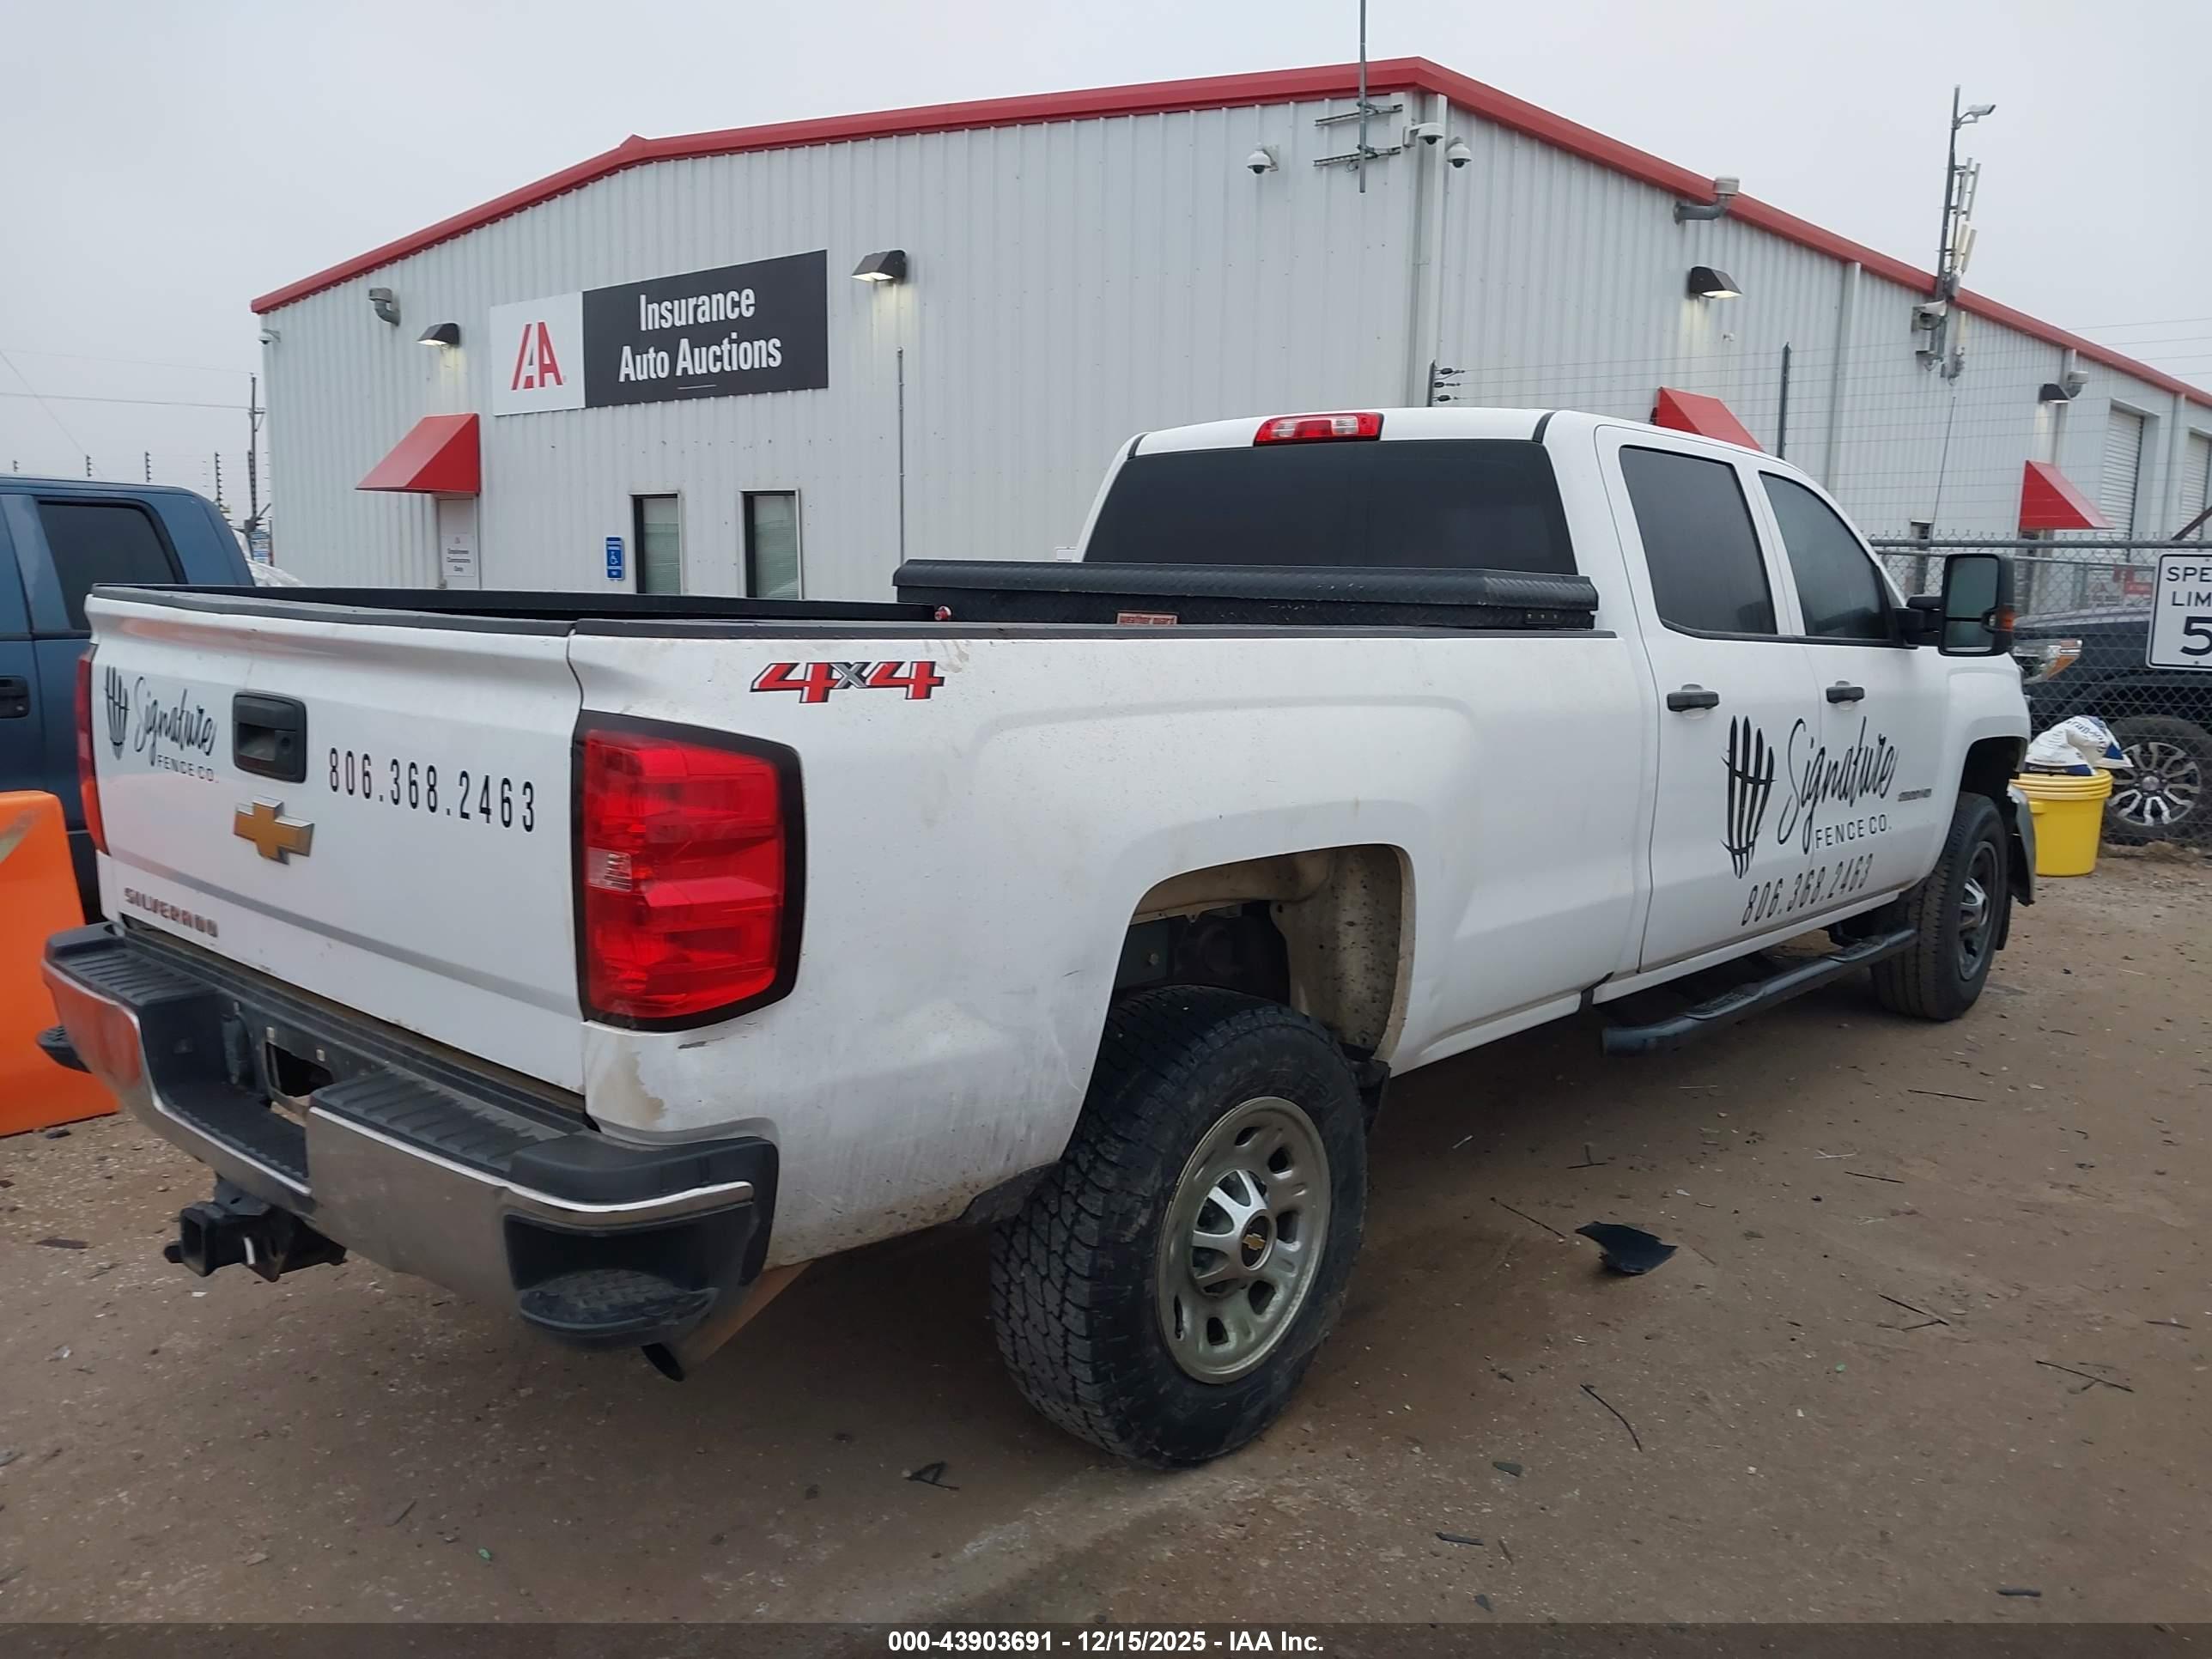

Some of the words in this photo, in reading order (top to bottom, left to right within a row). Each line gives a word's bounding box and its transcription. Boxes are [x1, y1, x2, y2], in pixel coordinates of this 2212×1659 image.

[640, 288, 756, 331] Insurance
[618, 345, 670, 383] Auto
[675, 332, 782, 377] Auctions
[134, 676, 217, 767] Signature
[157, 754, 195, 777] FENCE
[328, 747, 537, 833] 806.368.2463
[1778, 715, 1900, 855] Signature
[1814, 818, 1865, 849] FENCE
[124, 887, 218, 938] SILVERADO
[1741, 853, 1874, 927] 806.368.2463
